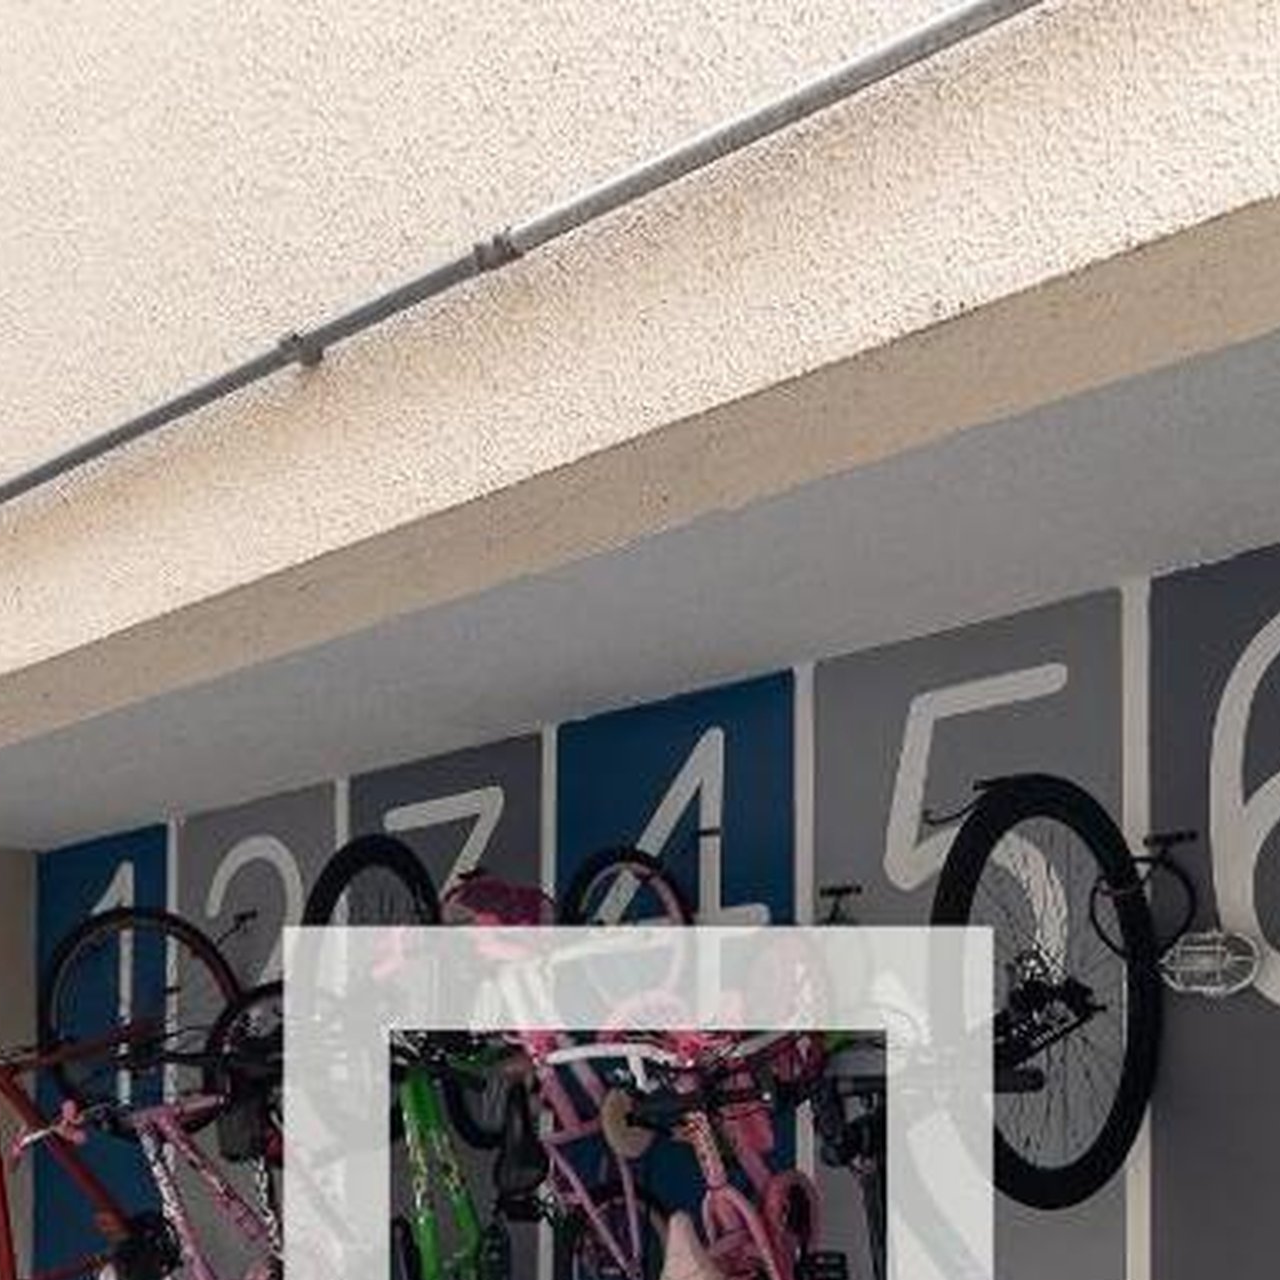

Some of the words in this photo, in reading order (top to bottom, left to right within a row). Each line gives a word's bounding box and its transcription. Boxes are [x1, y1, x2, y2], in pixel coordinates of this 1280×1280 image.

[586, 725, 770, 1018] 4
[883, 662, 1069, 985] 5
[91, 860, 135, 1106] 1
